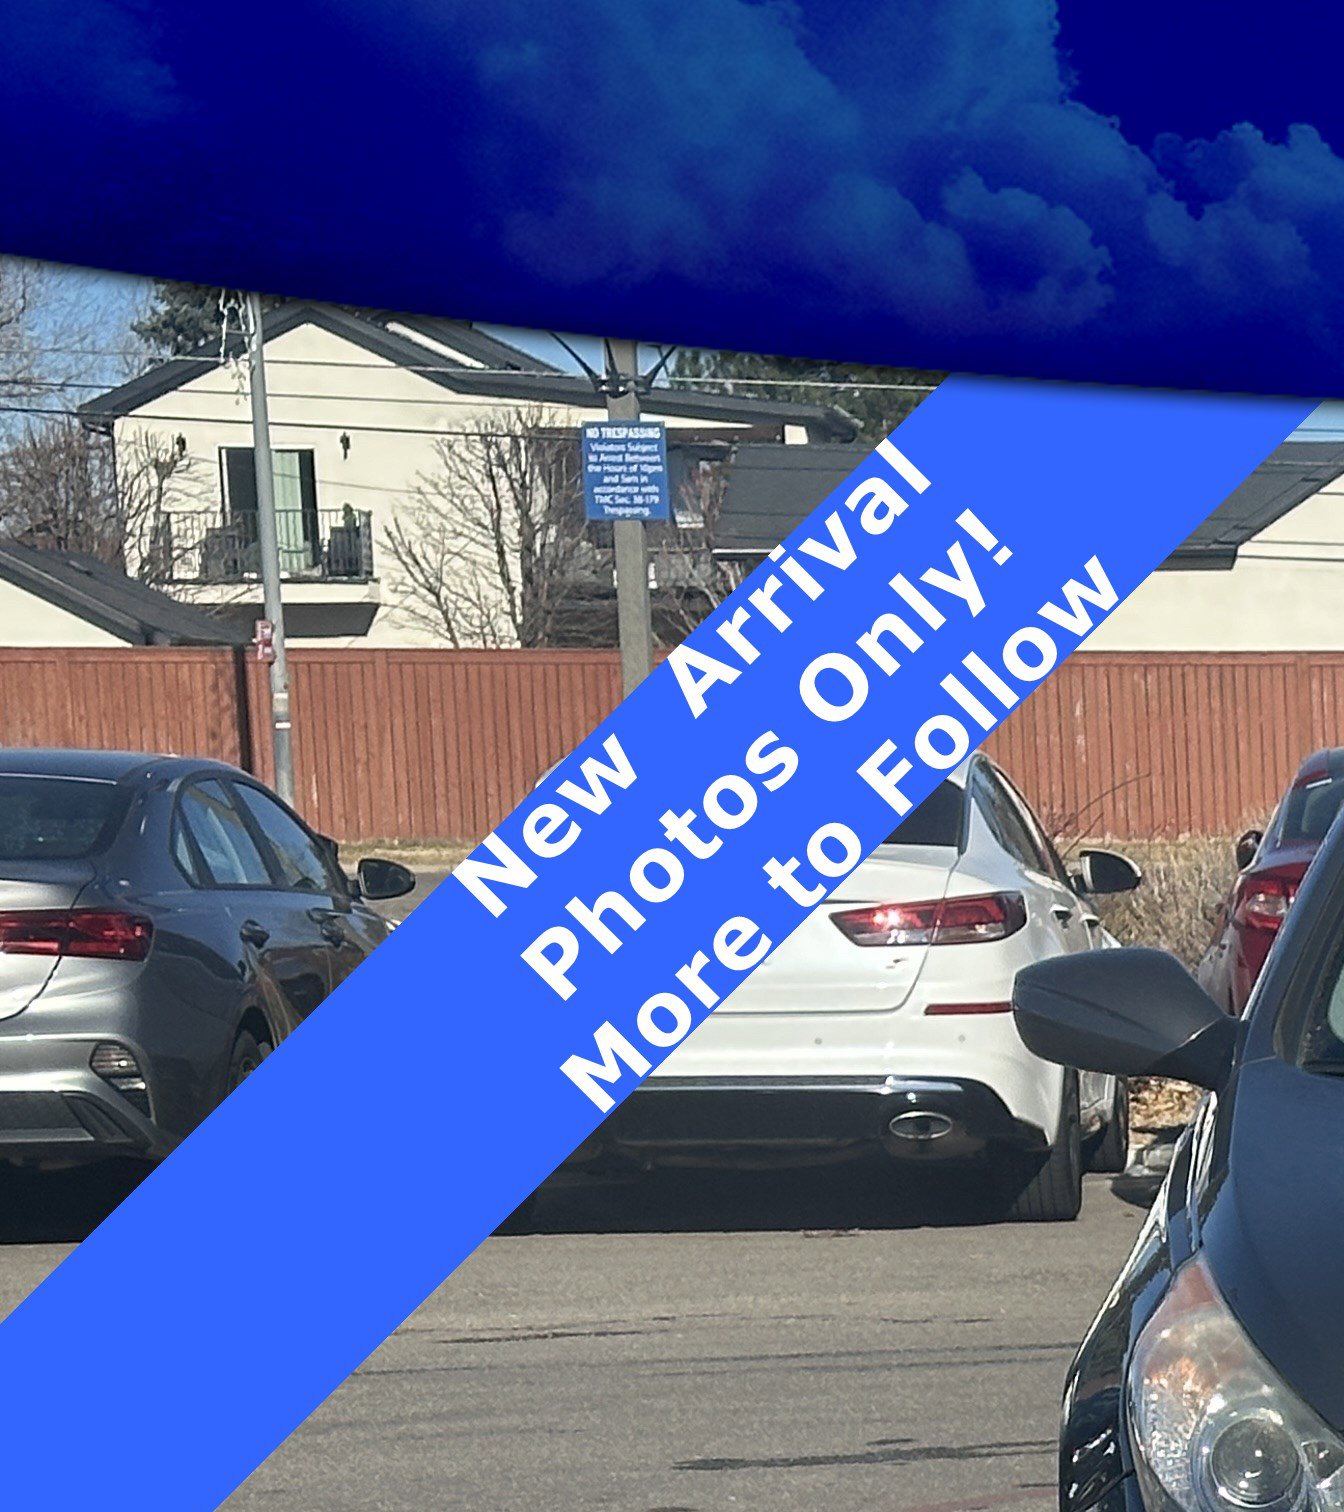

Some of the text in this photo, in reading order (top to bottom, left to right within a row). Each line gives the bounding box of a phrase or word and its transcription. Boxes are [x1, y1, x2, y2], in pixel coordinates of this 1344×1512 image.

[586, 427, 661, 439] NO TRESPASSING
[589, 442, 658, 453] Violators Subject
[599, 453, 623, 462] Arrest
[624, 453, 661, 463] Between
[587, 464, 602, 473] the
[603, 464, 627, 473] Hours
[629, 464, 637, 473] of
[603, 474, 619, 483] and
[640, 474, 649, 483] in
[593, 484, 660, 494] accordance with
